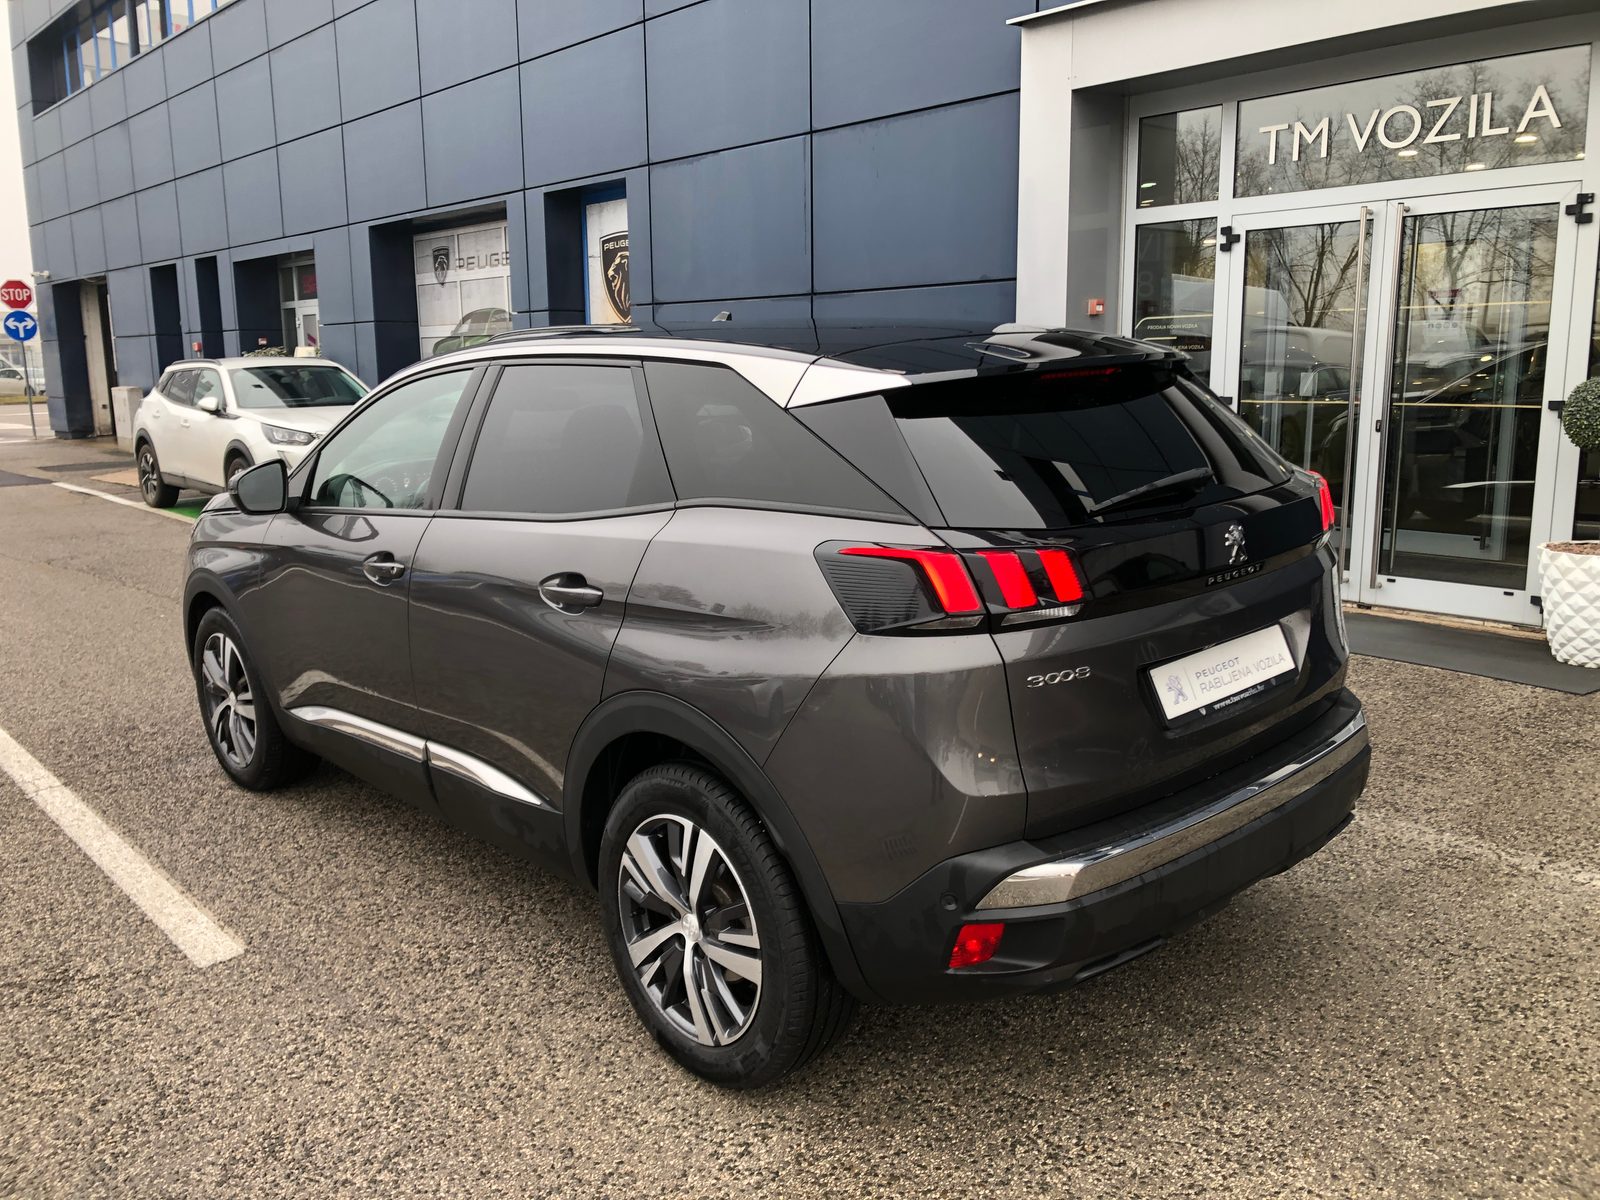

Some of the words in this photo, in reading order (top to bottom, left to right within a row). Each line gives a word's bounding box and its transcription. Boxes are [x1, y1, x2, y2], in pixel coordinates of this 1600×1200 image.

[1259, 116, 1330, 165] TM
[1346, 84, 1563, 153] VOZILA
[1, 288, 31, 301] STOP
[1208, 563, 1261, 585] PEUGEOT
[1026, 666, 1091, 688] 3008
[1195, 656, 1239, 679] PEUGEOT
[1200, 666, 1253, 694] RABLJENA
[1253, 653, 1286, 672] VOZILA
